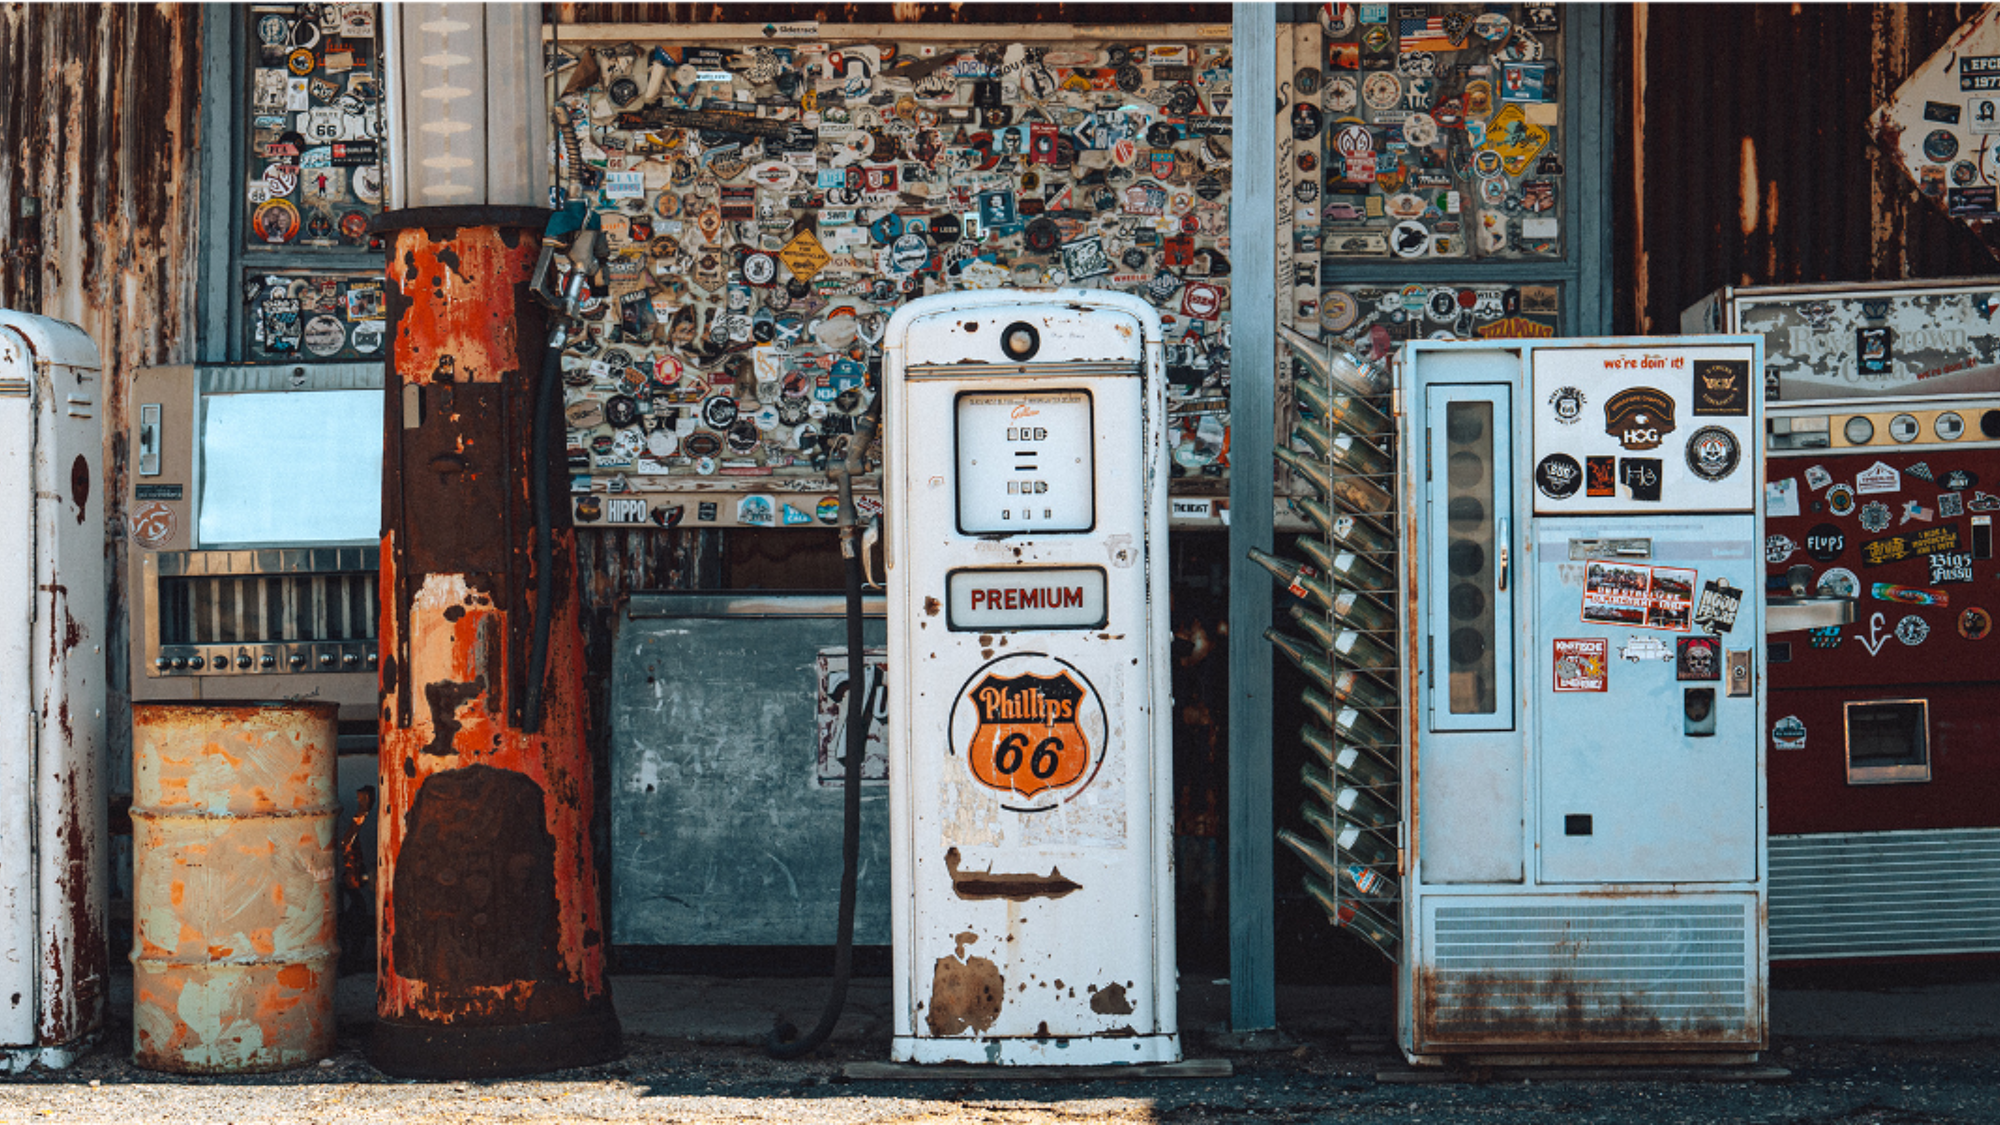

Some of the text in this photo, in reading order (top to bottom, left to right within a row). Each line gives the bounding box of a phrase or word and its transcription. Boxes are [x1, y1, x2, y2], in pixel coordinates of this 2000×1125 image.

[316, 125, 337, 137] 66
[1900, 328, 1968, 349] rown
[1604, 355, 1684, 369] we're doin' it!
[1623, 428, 1658, 443] HOG
[608, 500, 647, 523] HIPPO
[971, 587, 1084, 611] PREMIUM
[979, 686, 1073, 728] Phillips
[995, 732, 1065, 779] 66
